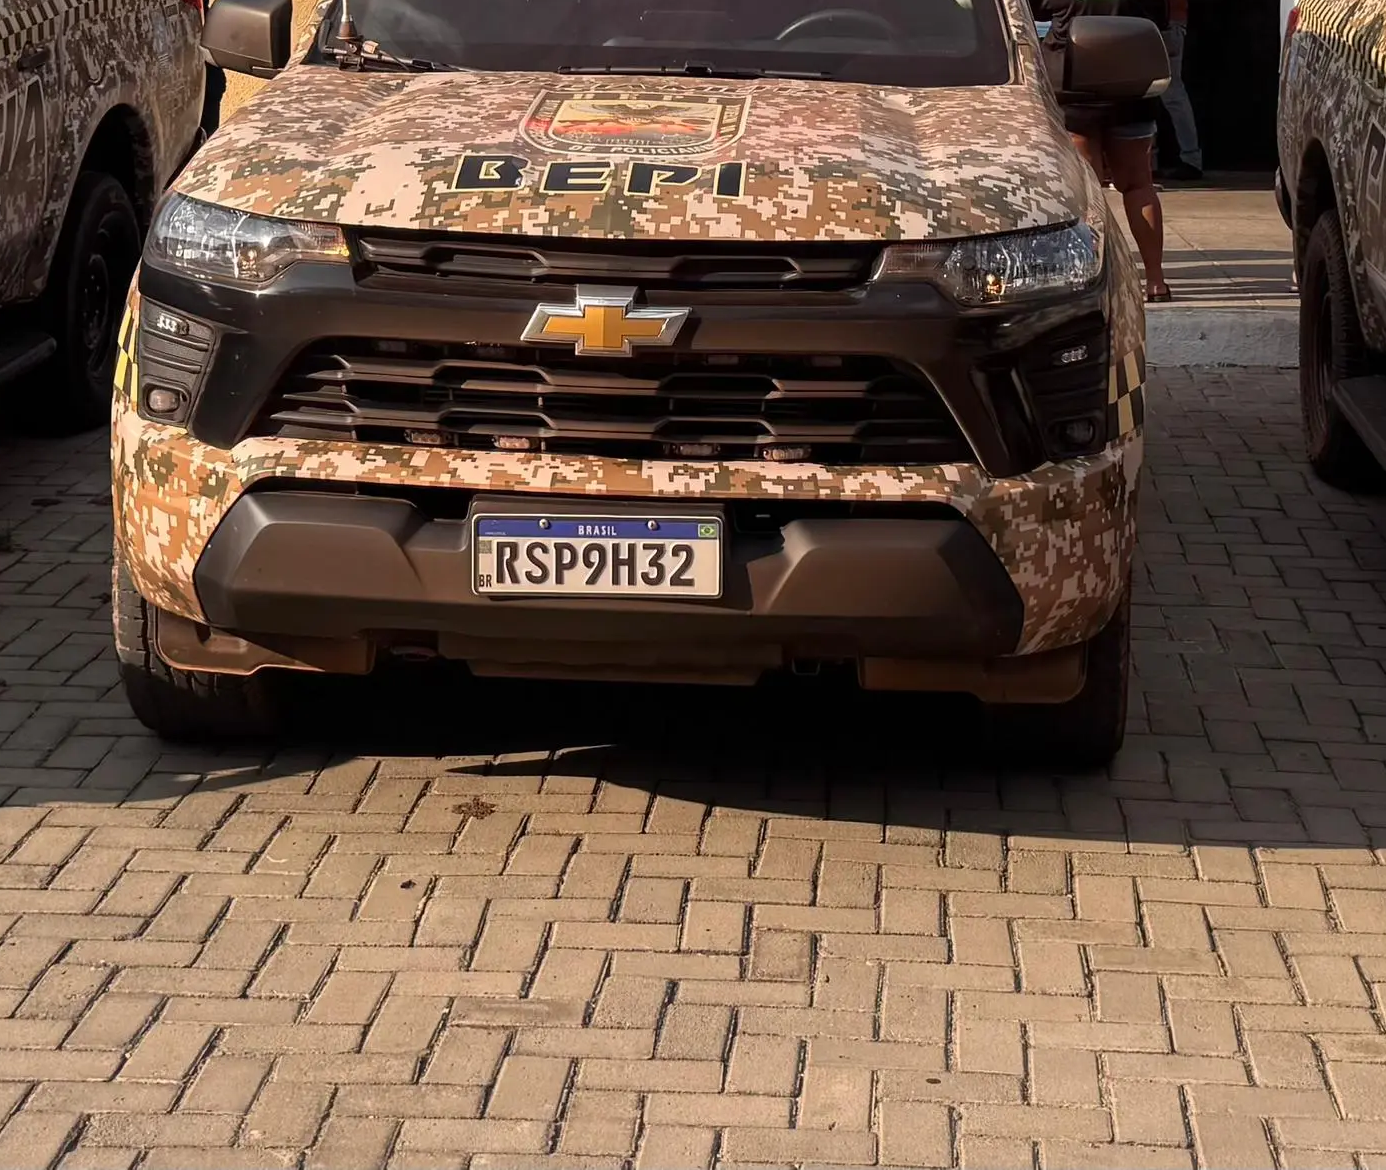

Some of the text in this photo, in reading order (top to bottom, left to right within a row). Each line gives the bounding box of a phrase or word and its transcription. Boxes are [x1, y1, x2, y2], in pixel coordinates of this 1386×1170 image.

[452, 153, 749, 198] BEPI
[578, 525, 617, 536] BRASIL
[495, 541, 696, 587] RSP9H32
[478, 574, 492, 588] BR
